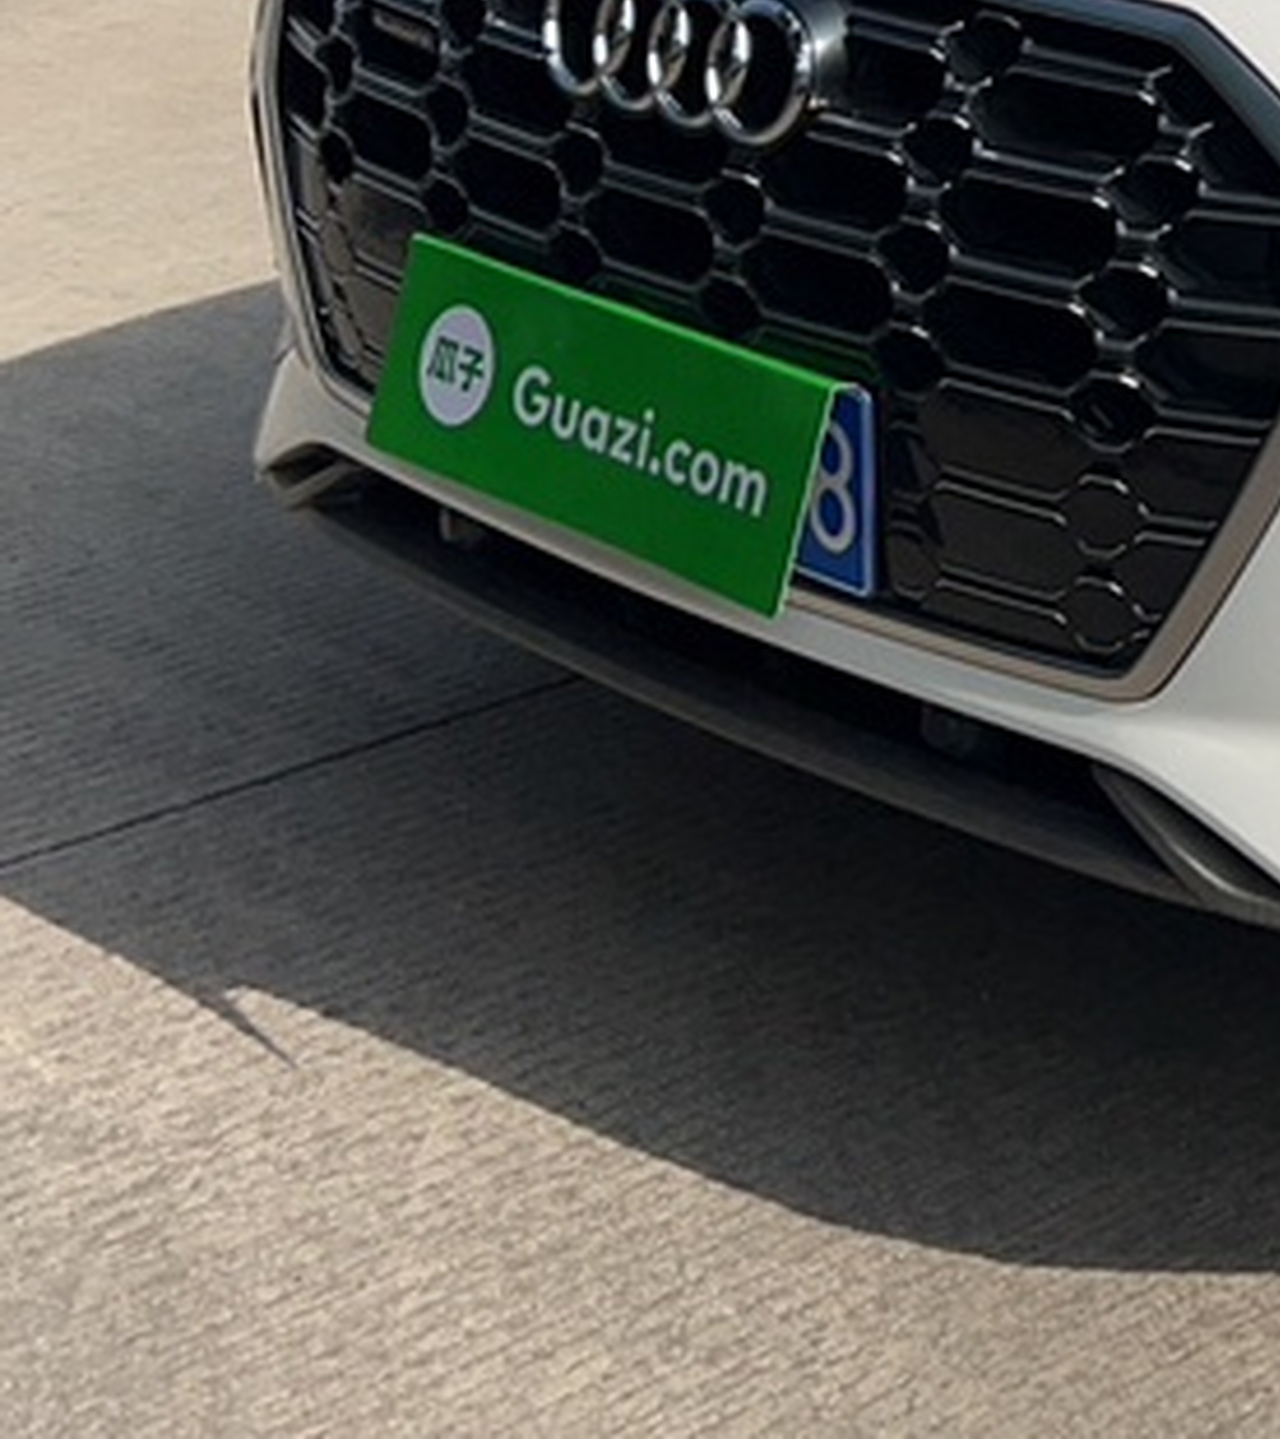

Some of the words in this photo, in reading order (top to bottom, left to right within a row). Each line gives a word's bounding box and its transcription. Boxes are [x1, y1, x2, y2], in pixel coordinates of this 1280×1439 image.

[426, 336, 484, 392] 瓜子
[512, 365, 768, 517] Guazi.com
[811, 420, 857, 555] 8
